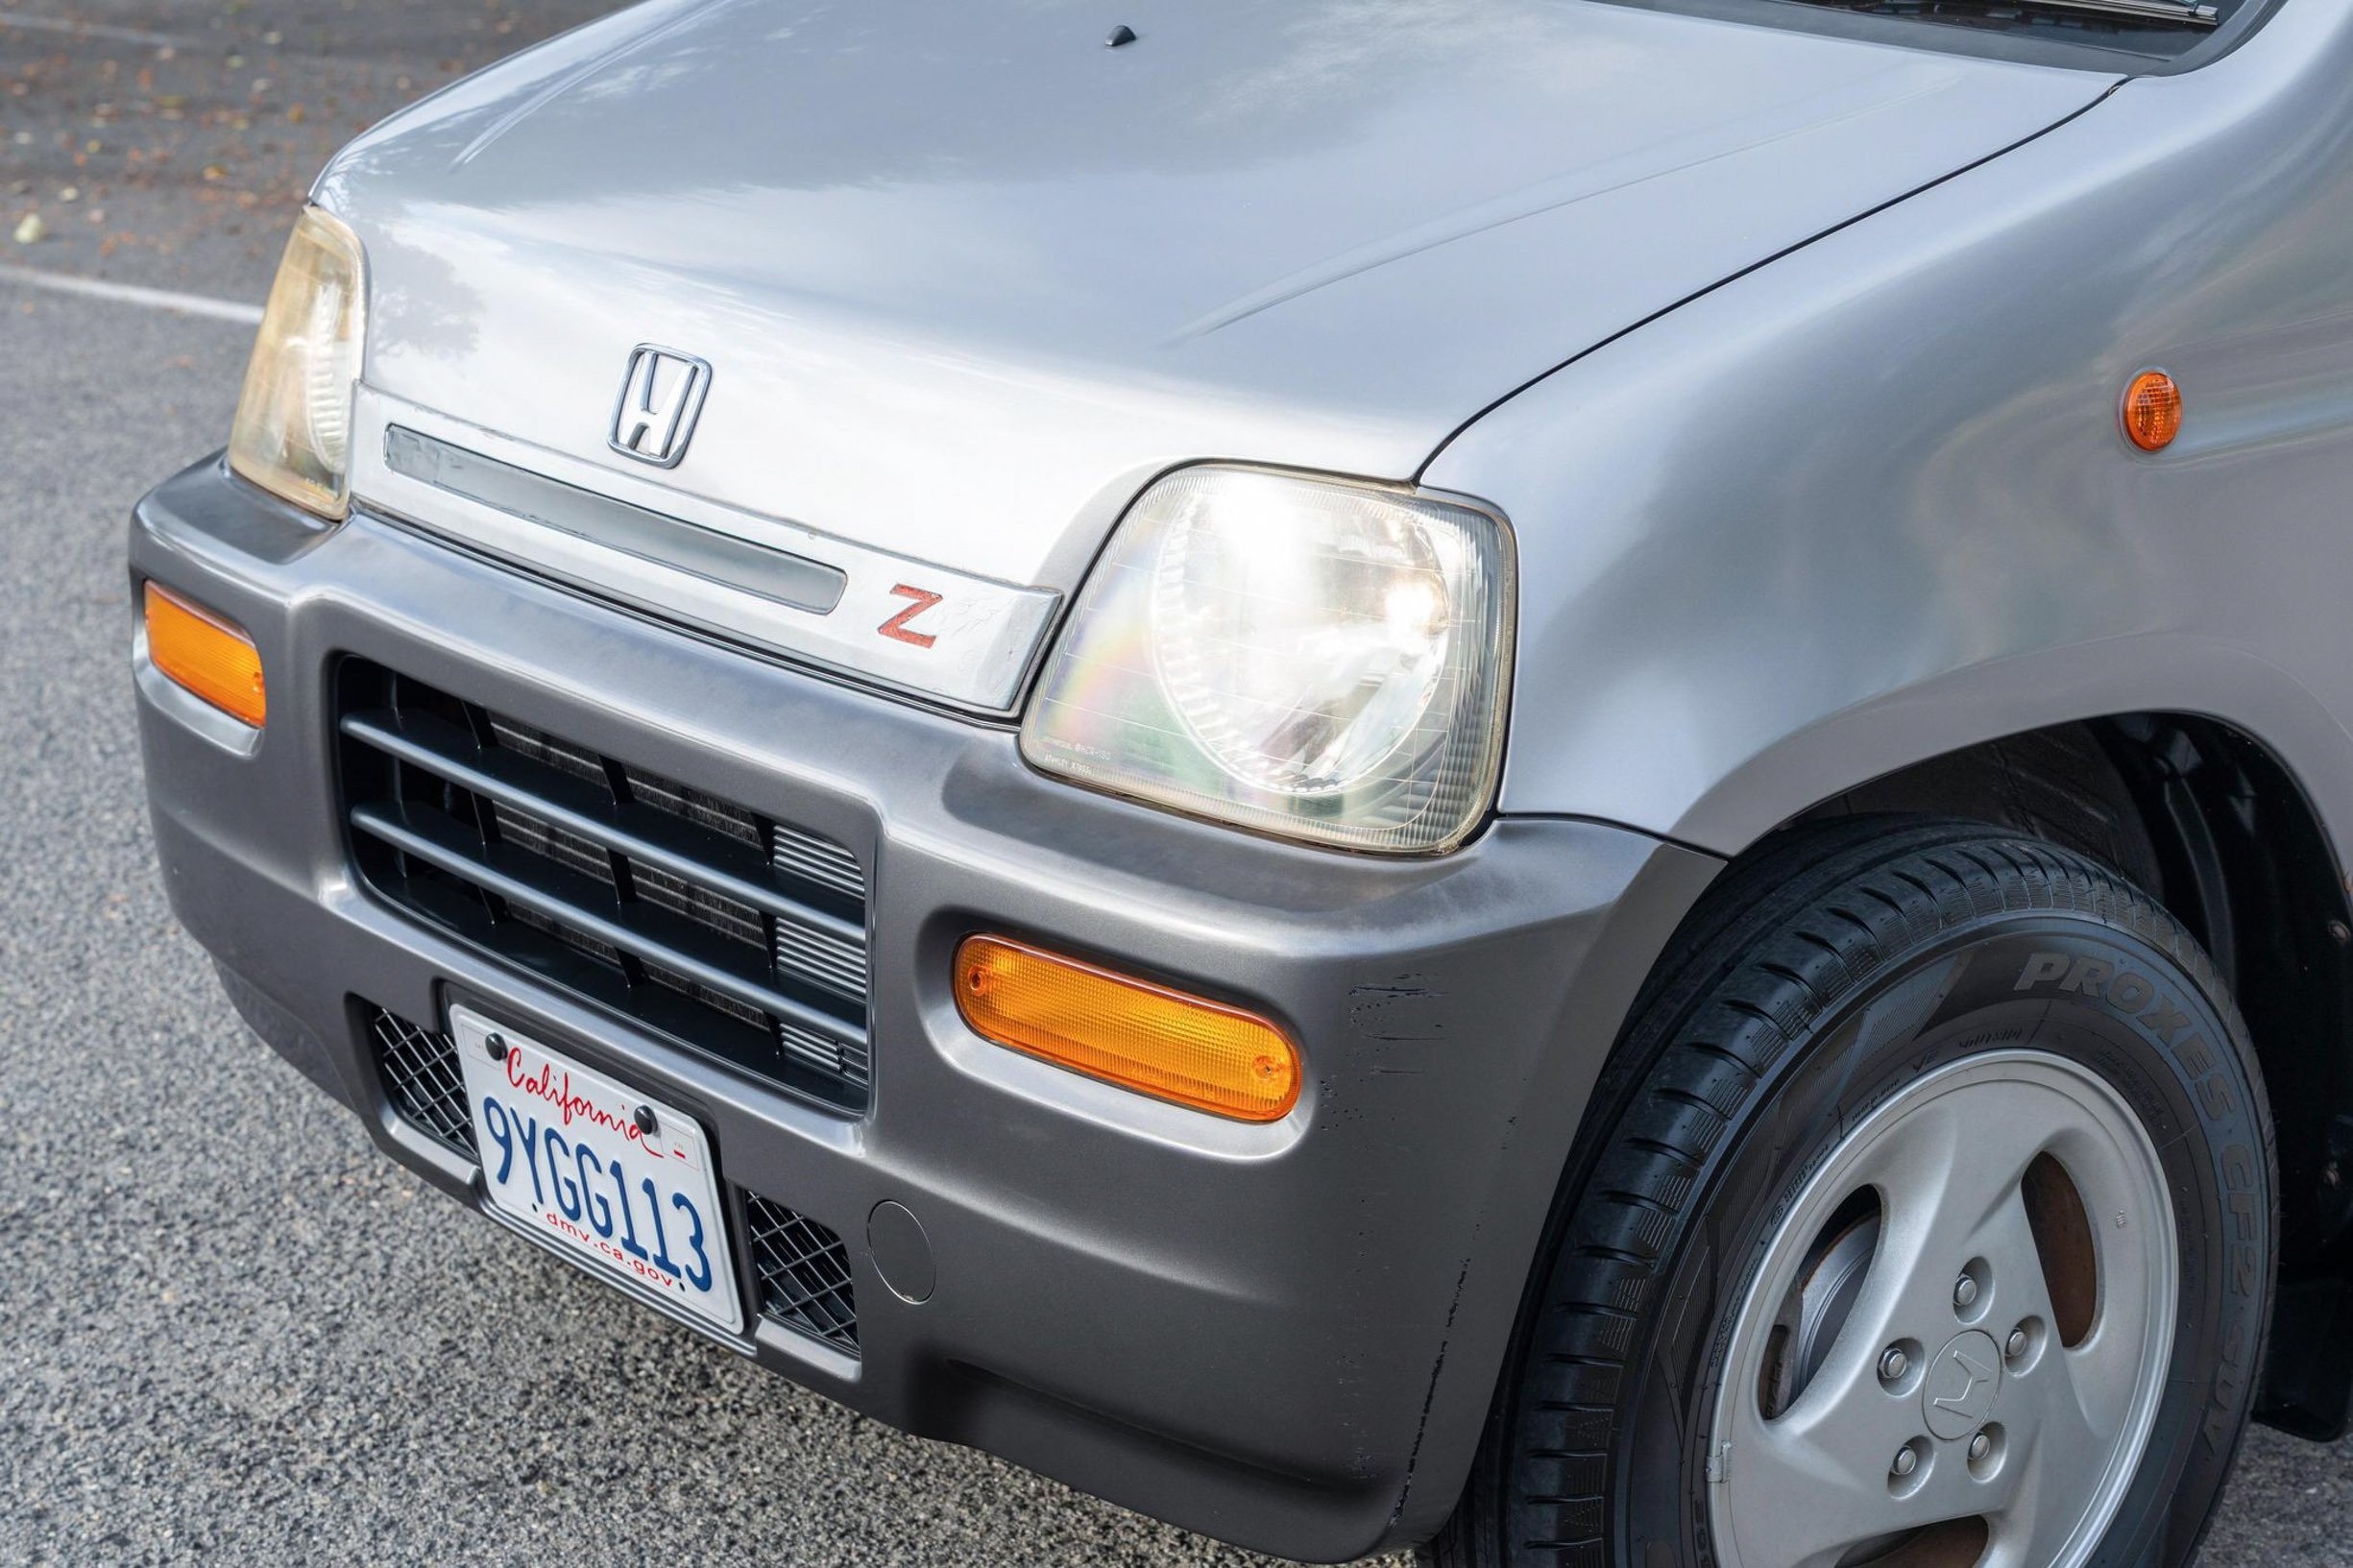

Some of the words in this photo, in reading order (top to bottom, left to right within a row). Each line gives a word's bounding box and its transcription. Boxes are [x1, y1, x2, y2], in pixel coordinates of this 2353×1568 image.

[877, 583, 943, 649] Z
[506, 1047, 665, 1159] California
[2012, 952, 2236, 1122] PROXES
[483, 1096, 712, 1292] 9YGG113
[546, 1212, 673, 1288] dmv.ca.gov
[2220, 1145, 2256, 1298] CF2
[2202, 1320, 2245, 1457] SUV
